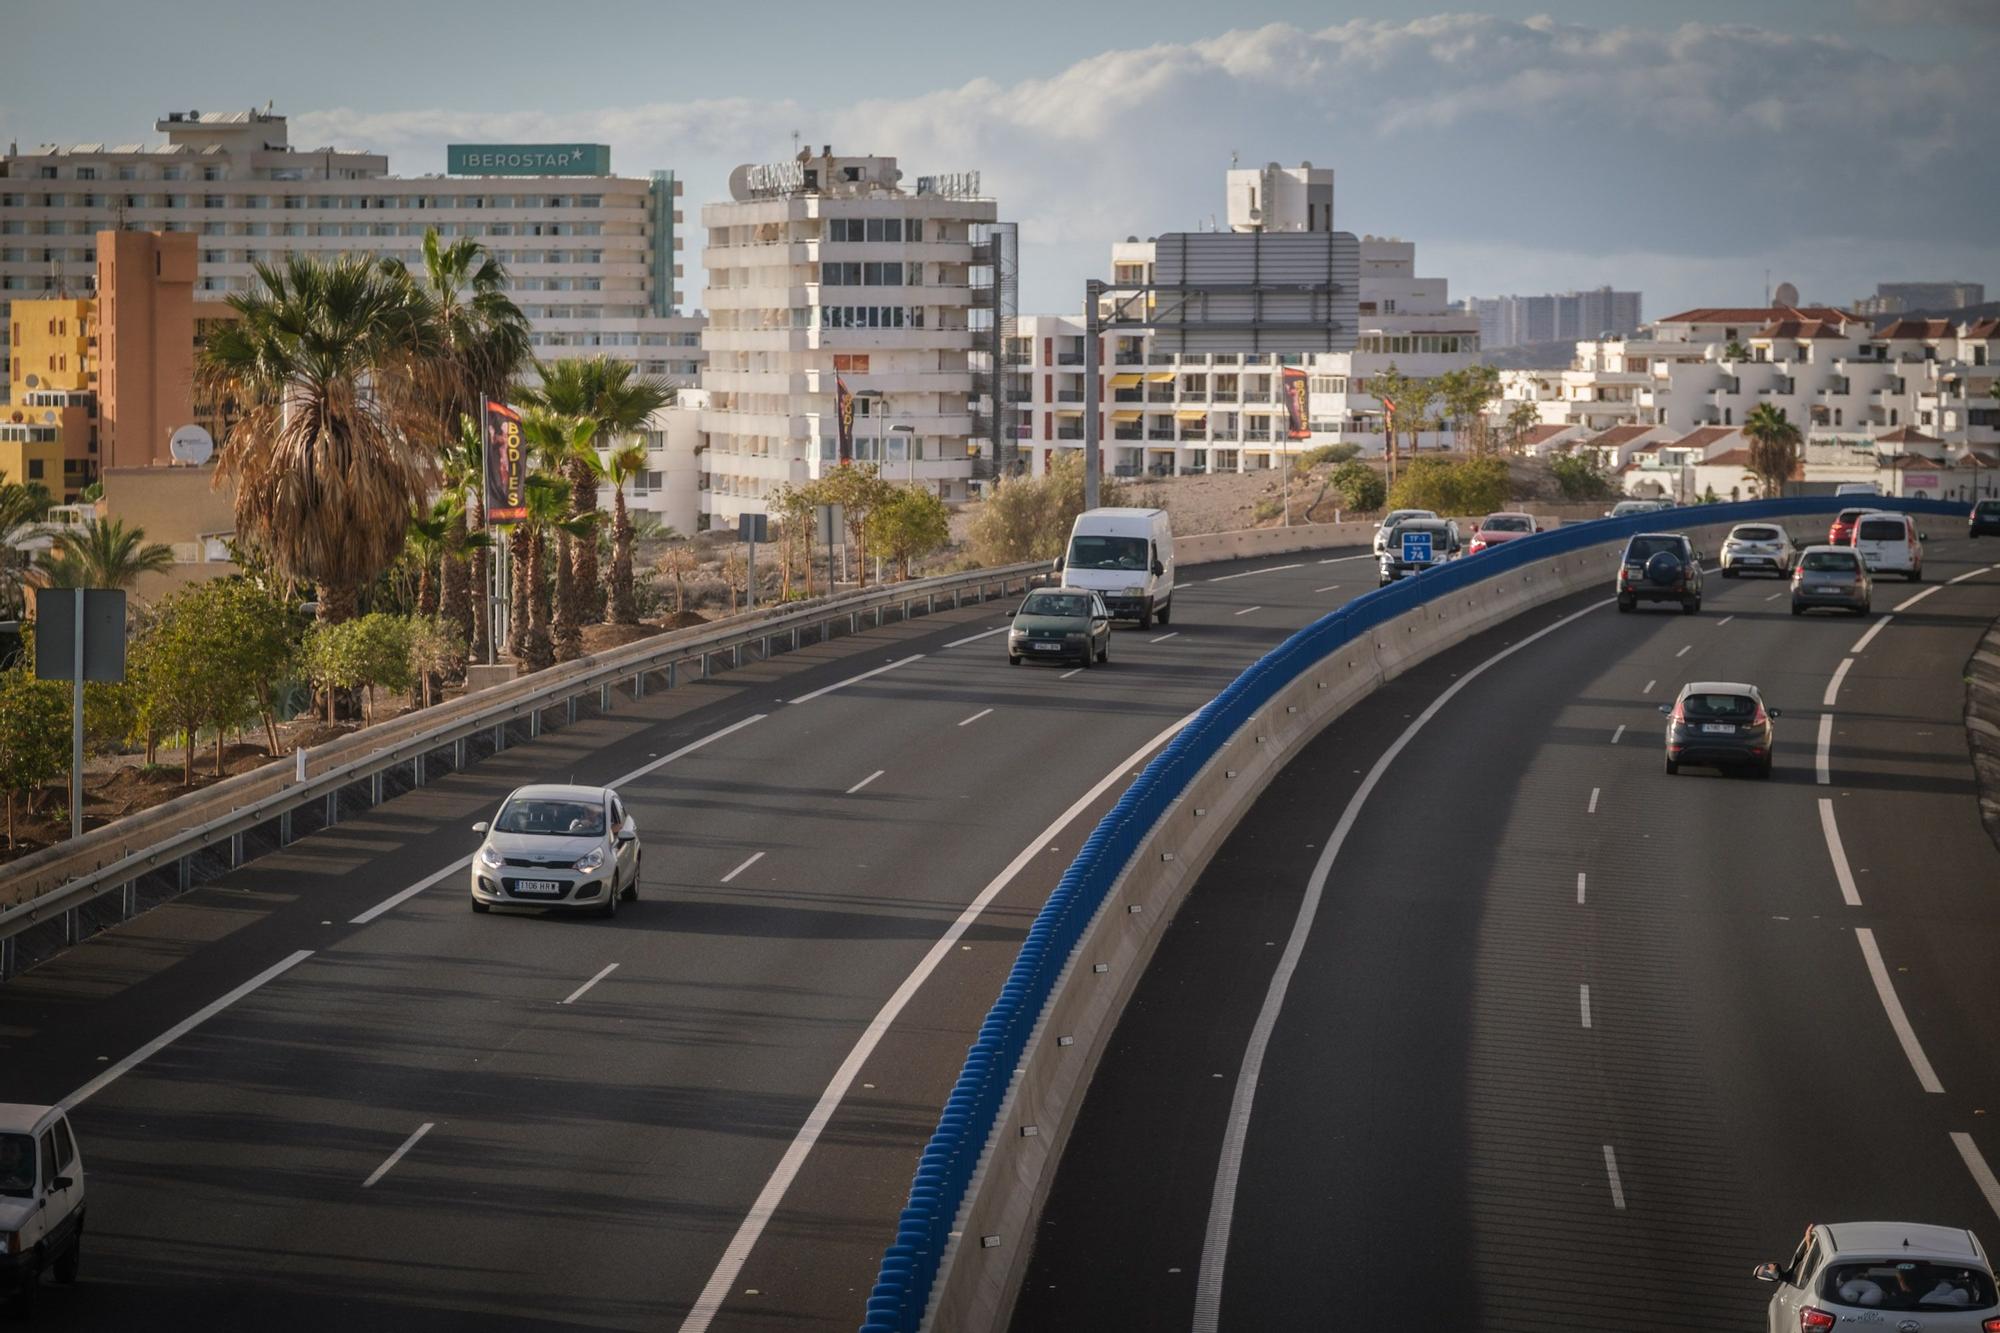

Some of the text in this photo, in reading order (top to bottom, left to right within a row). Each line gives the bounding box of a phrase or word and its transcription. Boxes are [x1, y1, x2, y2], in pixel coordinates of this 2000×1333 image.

[462, 153, 569, 167] IBEROSTAR
[507, 422, 520, 506] BODIES
[1410, 551, 1424, 560] 74
